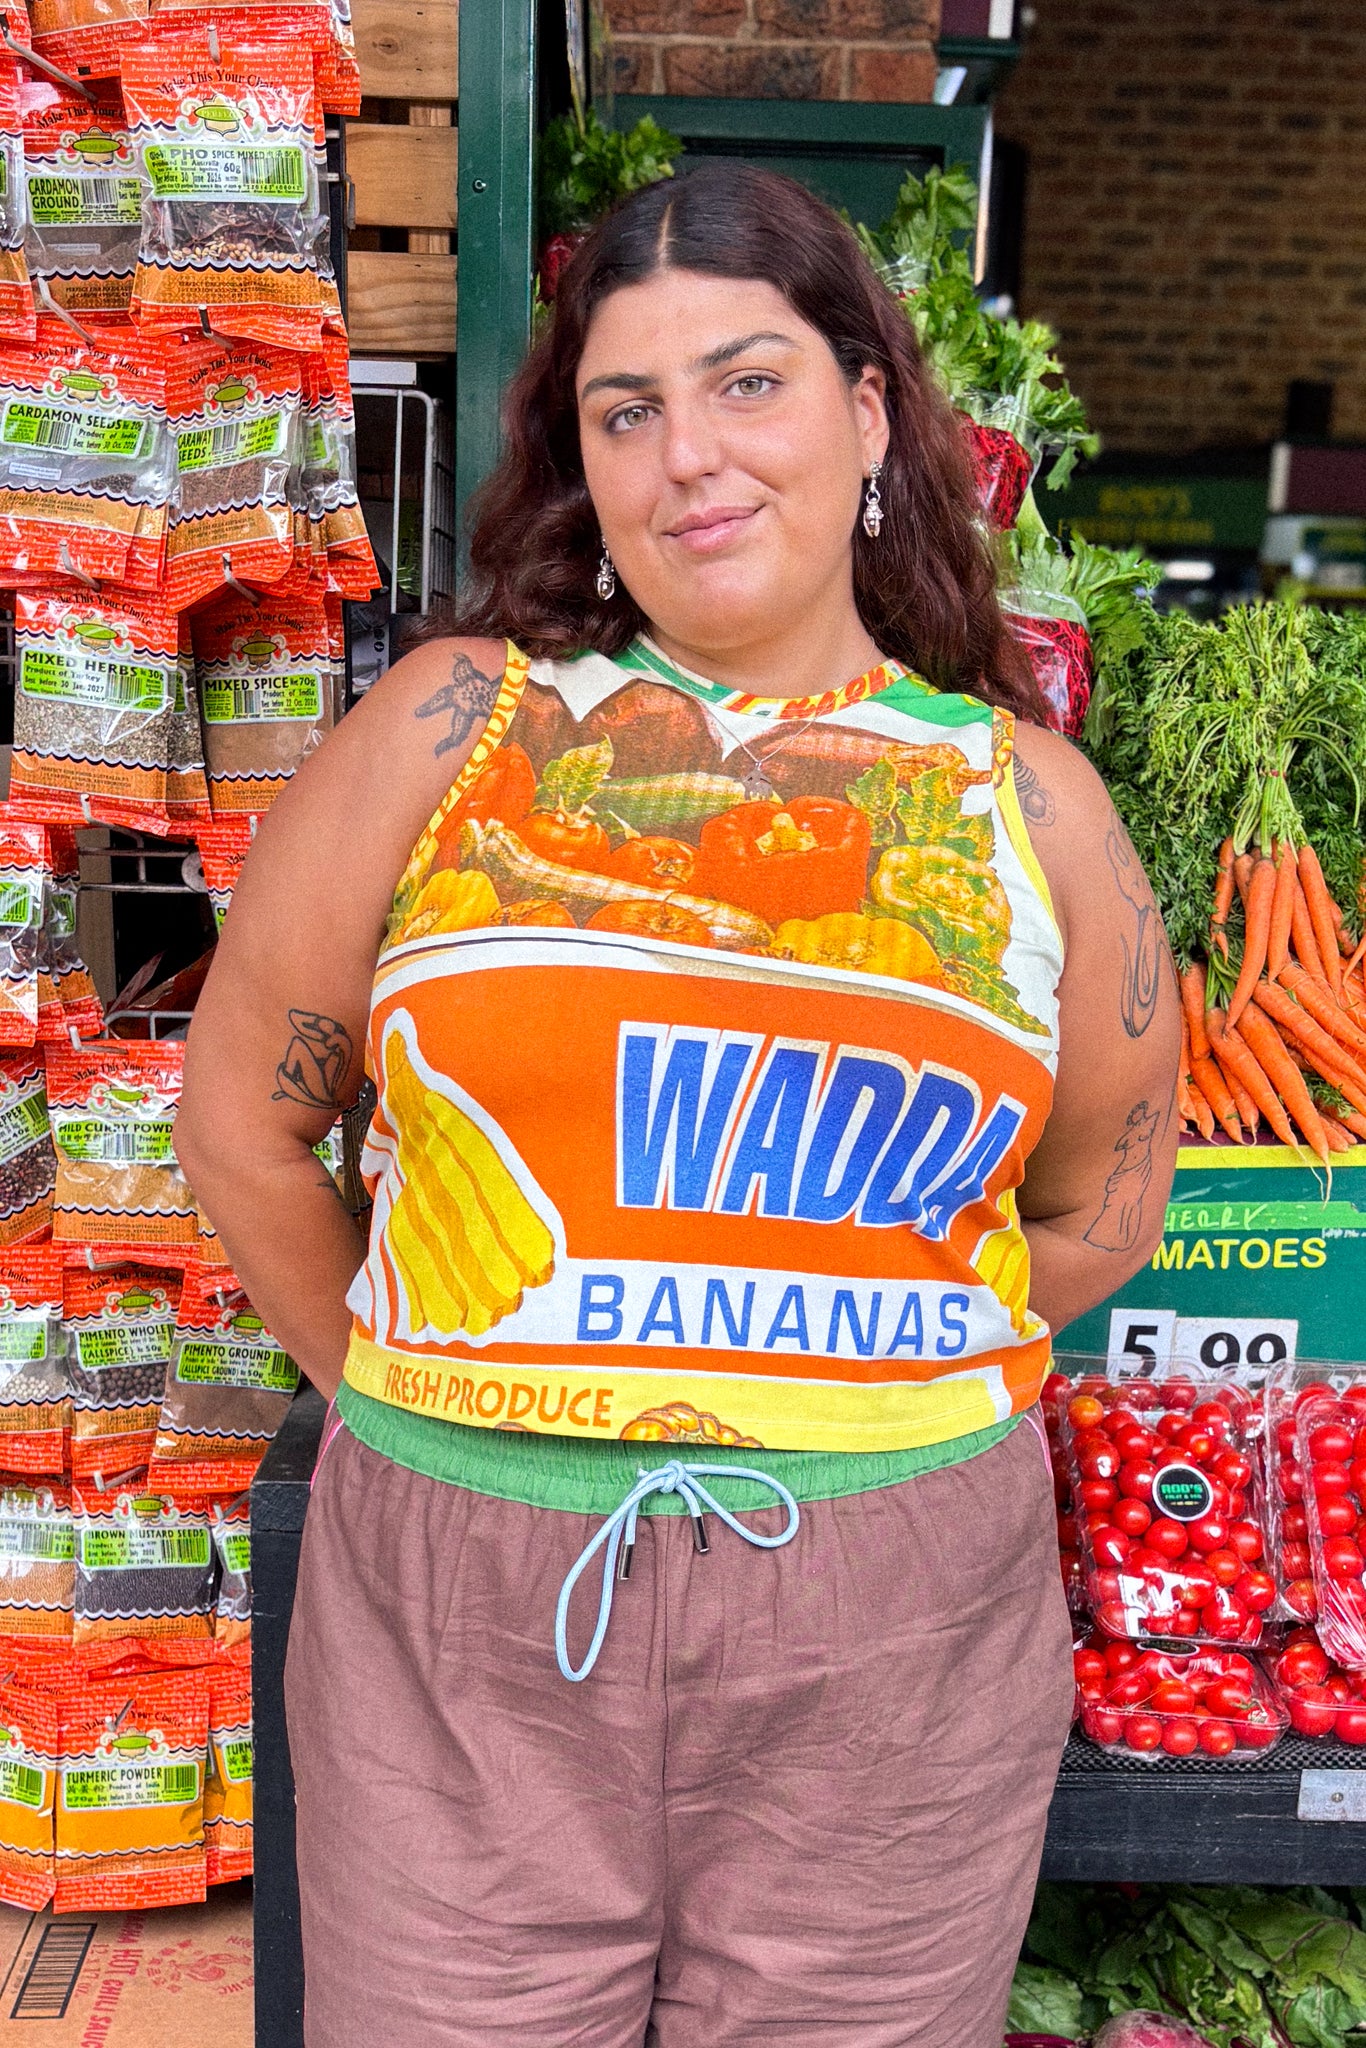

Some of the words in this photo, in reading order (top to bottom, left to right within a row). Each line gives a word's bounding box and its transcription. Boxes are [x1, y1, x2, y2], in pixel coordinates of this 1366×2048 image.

[187, 70, 213, 84] This
[216, 69, 245, 84] Your
[170, 148, 209, 160] PHO
[212, 150, 235, 160] SPICE
[238, 150, 265, 160] MIXED
[224, 162, 242, 174] 60g
[28, 178, 80, 196] CARDAMON
[32, 196, 79, 209] GROUND
[8, 404, 83, 425] CARDAMON
[86, 415, 123, 430] SEEDS
[178, 430, 212, 449] CARAWAY
[178, 447, 206, 463] SEEDS
[74, 594, 94, 604] This
[97, 594, 122, 609] Your
[25, 651, 78, 668] MIXED
[85, 660, 139, 677] HERBS
[25, 664, 56, 677] Product
[58, 670, 68, 678] of
[40, 676, 58, 688] before
[88, 683, 105, 694] 2027
[205, 678, 250, 693] MIXED
[254, 677, 289, 690] SPICE
[298, 677, 316, 687] 70g
[617, 1023, 1027, 1241] WADDA
[1151, 1238, 1327, 1270] MATOES
[0, 1266, 33, 1284] Choice
[576, 1273, 970, 1357] BANANAS
[79, 1328, 125, 1342] PIMENTO
[129, 1324, 166, 1337] WHOLE
[184, 1345, 225, 1357] PIMENTO
[229, 1347, 271, 1361] GROUND
[384, 1362, 441, 1410] FRESH
[444, 1374, 615, 1428] PRODUCE
[1160, 1484, 1203, 1495] ROD'S
[178, 1528, 205, 1538] SEEDS
[66, 1769, 117, 1784] TURMERIC
[120, 1767, 162, 1781] POWDER
[93, 1979, 124, 2012] CHILI
